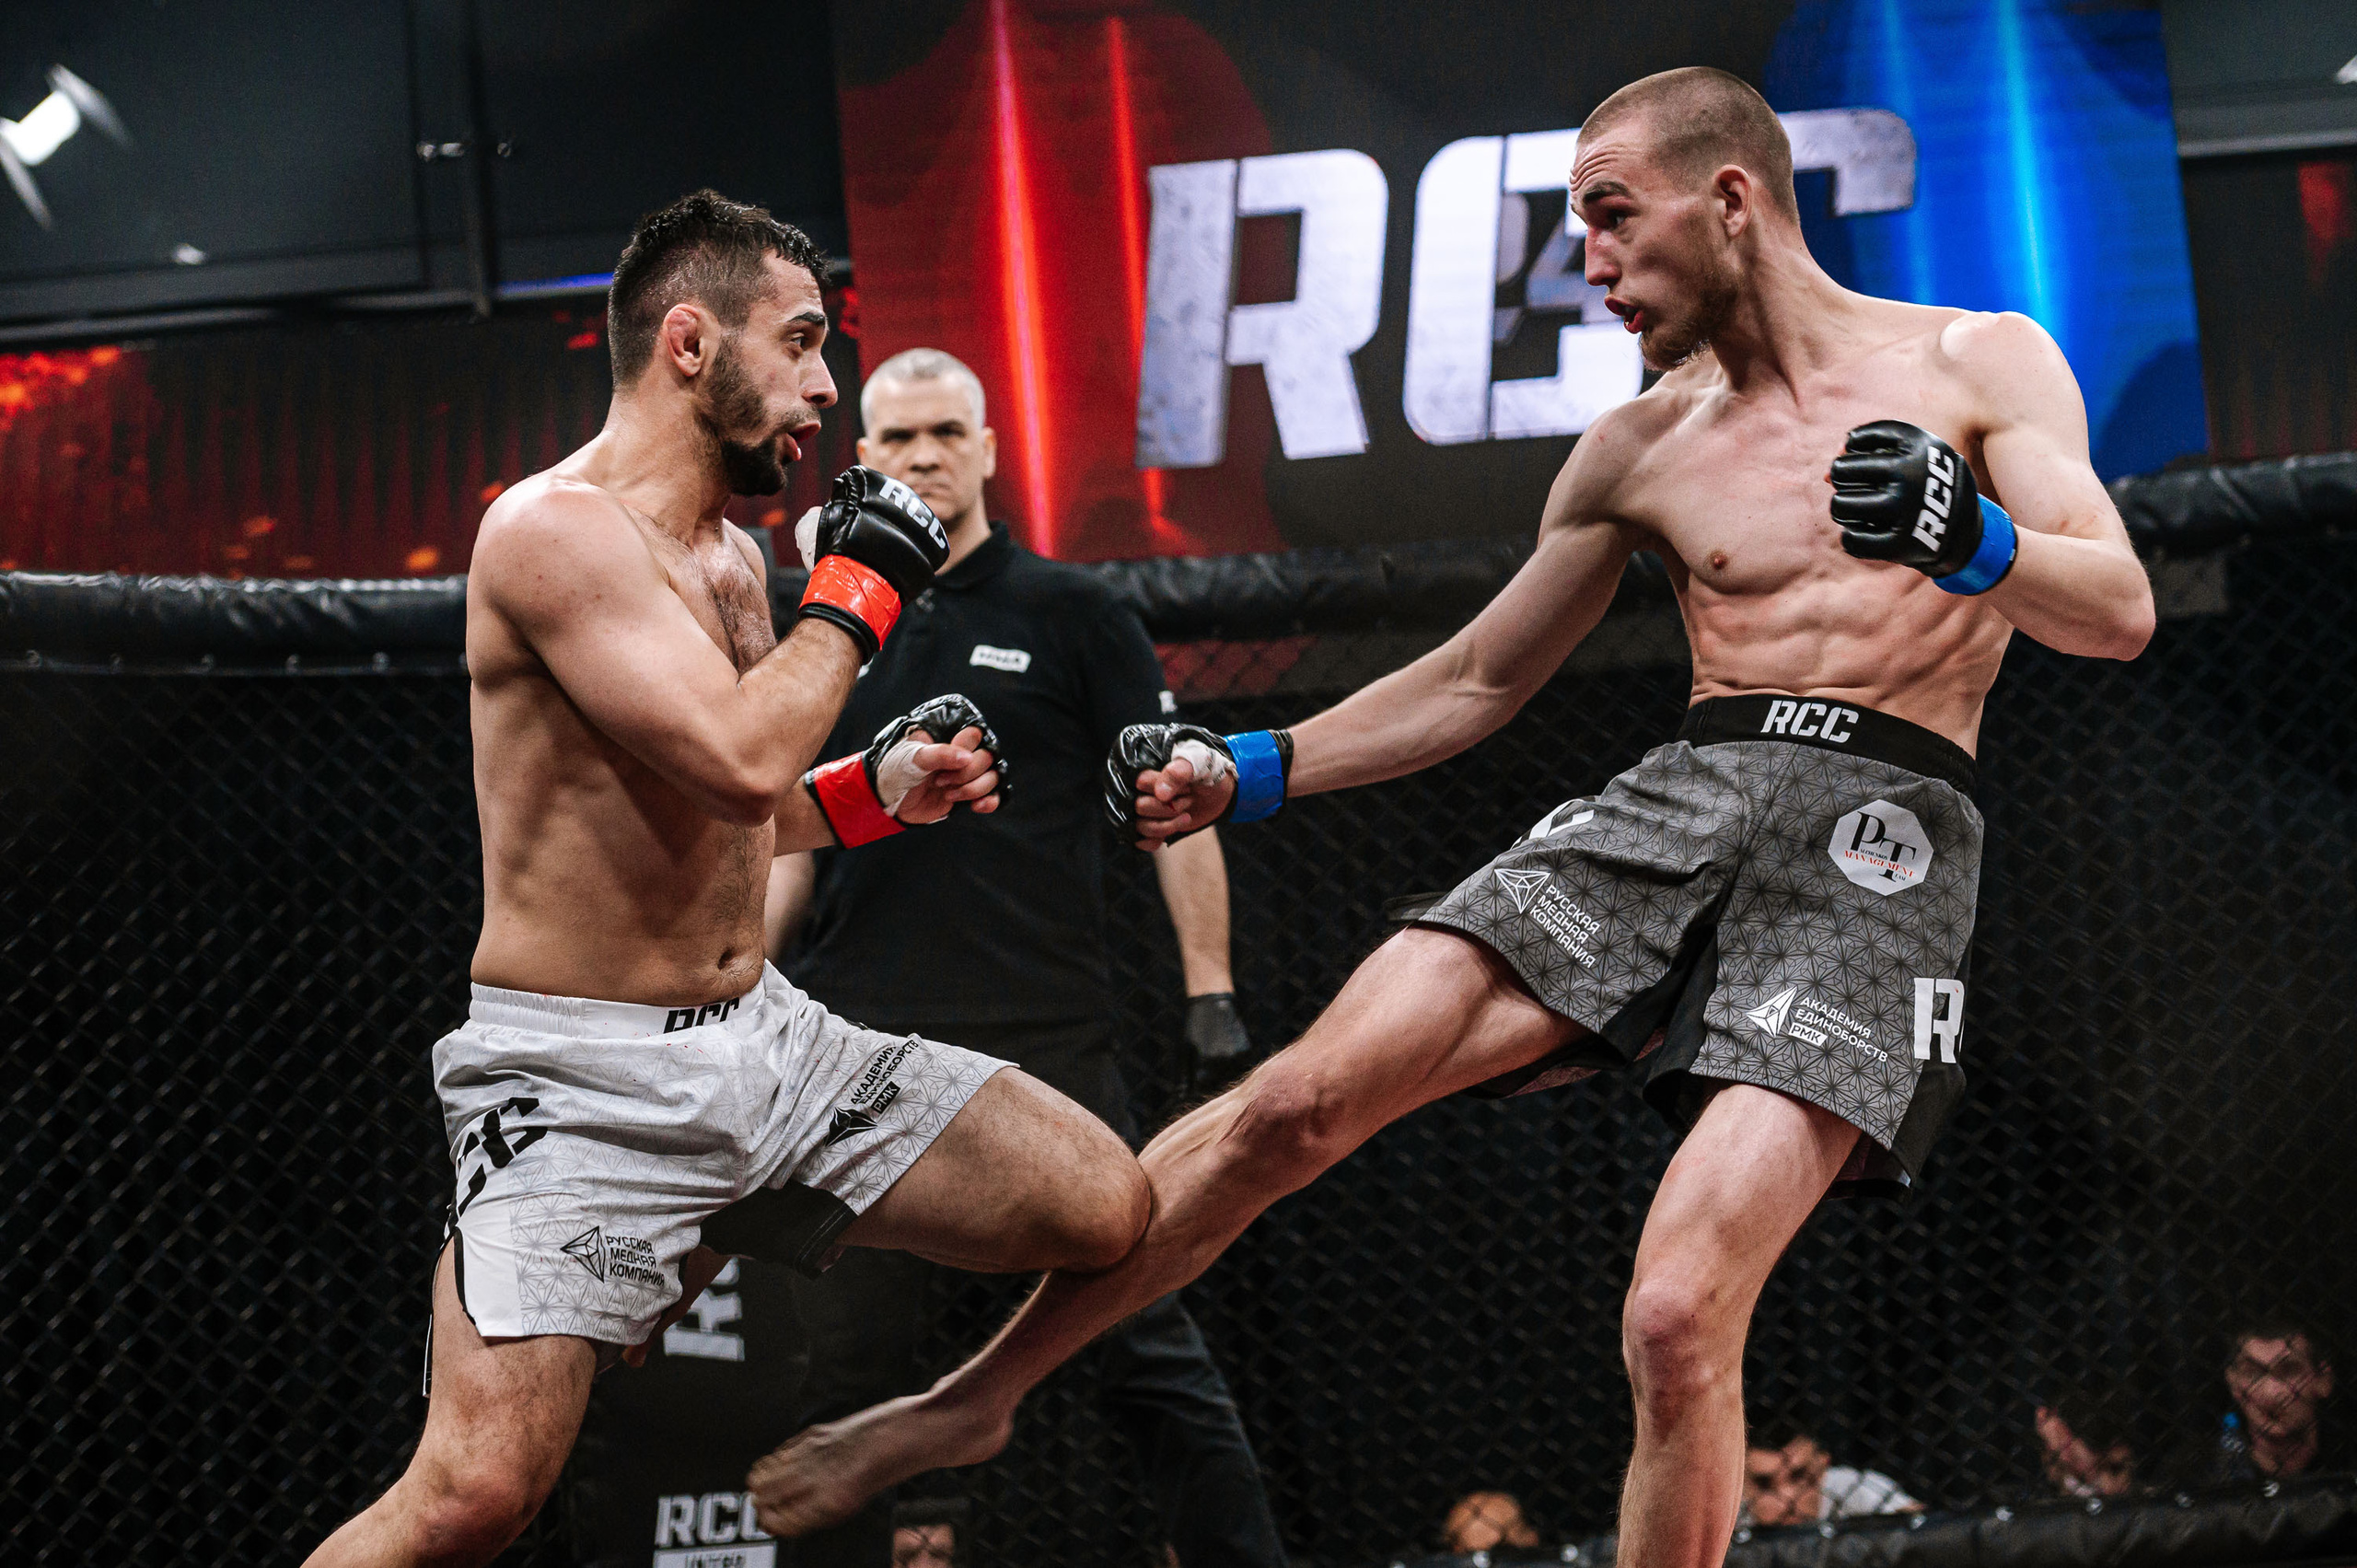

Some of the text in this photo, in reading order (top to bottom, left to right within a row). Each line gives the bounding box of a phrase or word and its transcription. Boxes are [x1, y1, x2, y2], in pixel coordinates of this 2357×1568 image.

[878, 478, 949, 550] RCC
[1911, 446, 1955, 552] RCC
[1759, 700, 1860, 743] RCC
[1844, 849, 1915, 877] MANAGEMENT
[1537, 894, 1589, 945] МЕДНАЯ
[1546, 884, 1601, 935] РУССКАЯ
[1529, 904, 1596, 969] КОМПАНИЯ
[1791, 1024, 1821, 1044] РМК
[1794, 1008, 1888, 1063] ЕДИНОБОРСТВ
[1800, 996, 1872, 1040] АКАДЕМИЯ
[1913, 977, 1966, 1064] R
[873, 1085, 899, 1112] РМК
[605, 1235, 655, 1255] РУССКАЯ
[610, 1248, 657, 1268] МЕДНАЯ
[610, 1262, 666, 1286] КОМПАНИЯ
